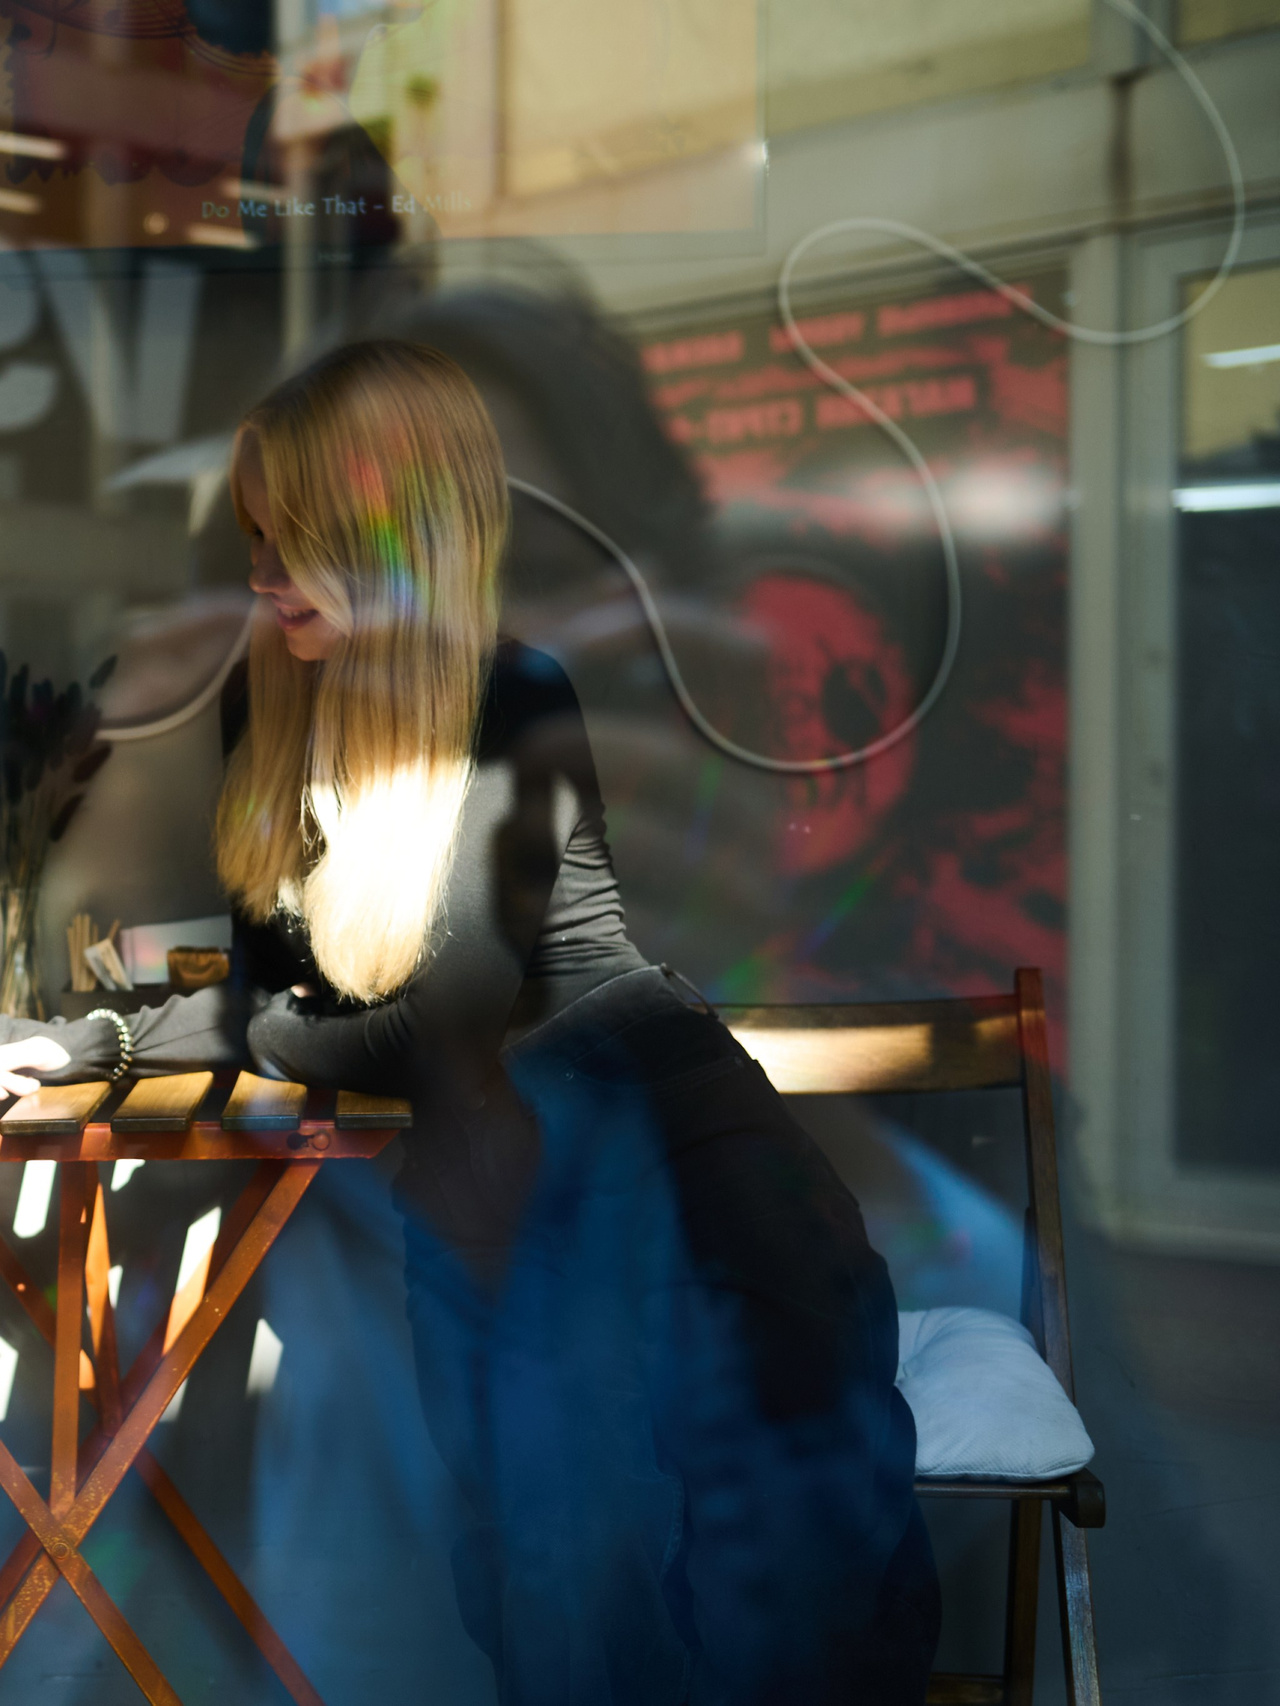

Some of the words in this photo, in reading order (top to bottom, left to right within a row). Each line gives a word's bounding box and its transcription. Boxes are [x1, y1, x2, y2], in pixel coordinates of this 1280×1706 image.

[201, 200, 230, 219] Do
[237, 199, 267, 217] Me
[274, 196, 315, 216] Like
[322, 194, 367, 216] That
[391, 194, 415, 214] Ed
